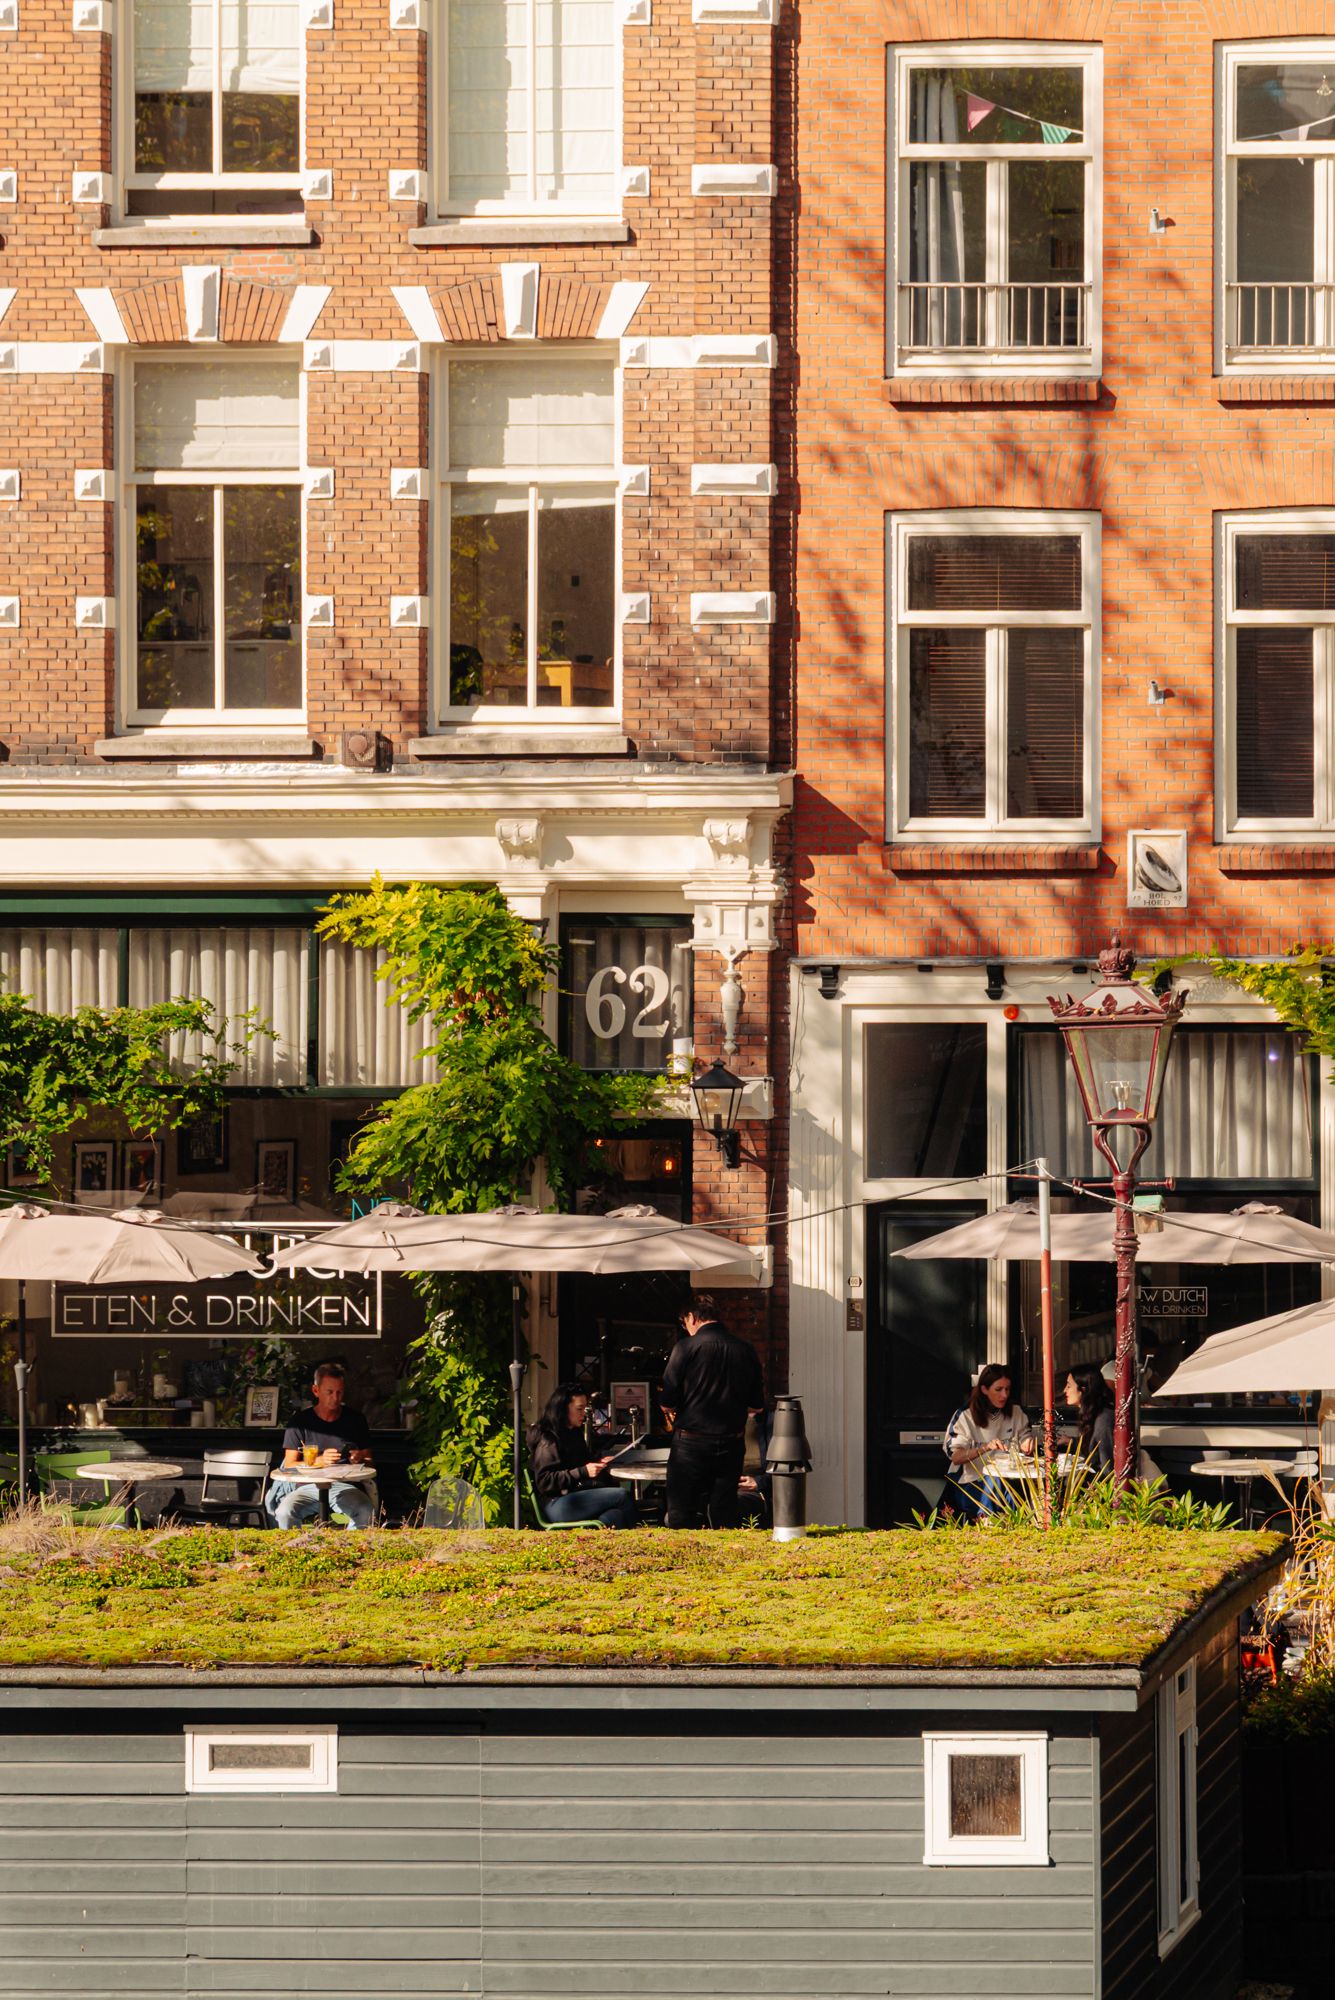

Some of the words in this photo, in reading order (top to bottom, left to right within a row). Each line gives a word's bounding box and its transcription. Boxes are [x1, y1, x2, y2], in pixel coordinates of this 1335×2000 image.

[586, 965, 670, 1039] 62
[1163, 1290, 1204, 1302] DUTCH
[63, 1295, 156, 1325] ETEN
[167, 1295, 197, 1326] &
[207, 1295, 370, 1326] DRINKEN
[1152, 1305, 1161, 1314] &
[1163, 1306, 1205, 1314] DRINKEN
